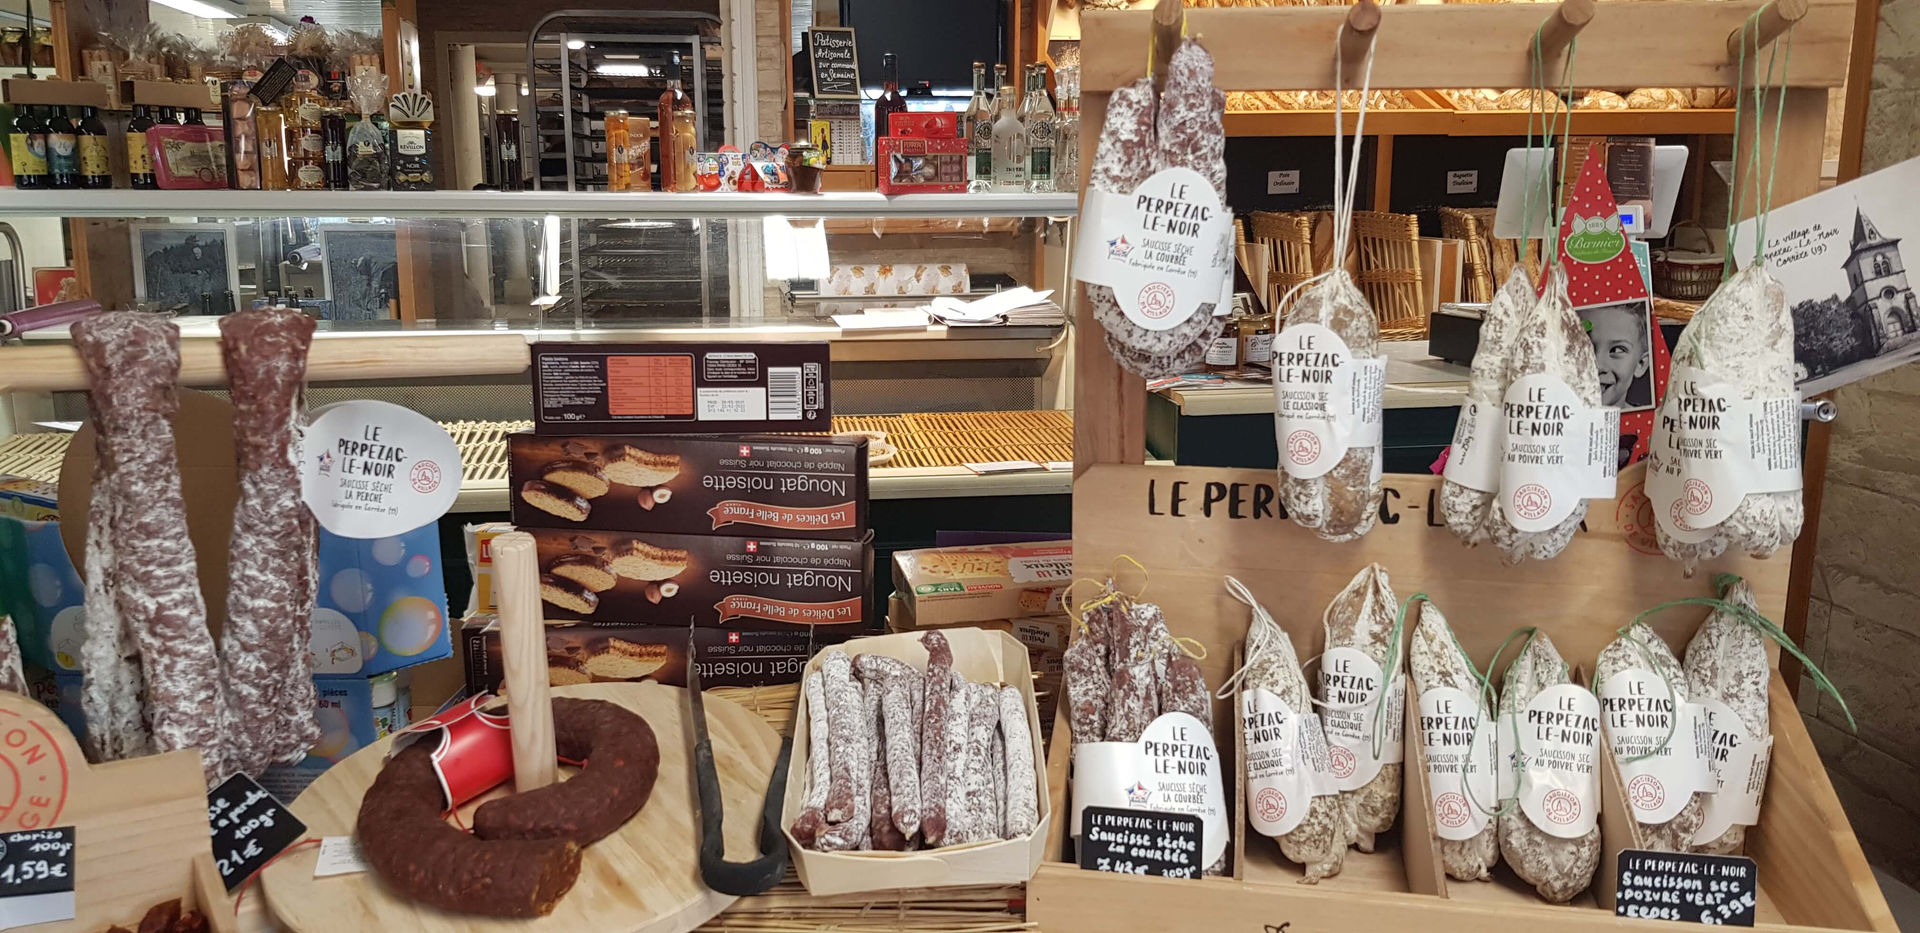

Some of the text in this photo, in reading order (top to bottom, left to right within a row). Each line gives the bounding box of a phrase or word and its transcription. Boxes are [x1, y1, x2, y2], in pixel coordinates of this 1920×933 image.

[1170, 182, 1189, 200] LE
[1136, 195, 1213, 221] PERPEZAC-
[1143, 214, 1200, 238] LE-NOIR
[1783, 228, 1810, 243] village
[1812, 223, 1822, 232] de
[1141, 238, 1171, 251] SAUCISSE
[1569, 235, 1620, 250] Barnier
[1144, 250, 1188, 266] LA COURBÉE
[1300, 335, 1316, 350] LE
[1272, 352, 1345, 367] PERPEZAC-
[1278, 368, 1333, 384] LE-NOIR
[1528, 387, 1547, 403] LE
[1684, 380, 1697, 396] LE
[1282, 391, 1329, 401] SAUCISSON SEC
[1283, 401, 1327, 412] LE CLASSIQUE
[1503, 402, 1575, 420] PERPEZAC-
[364, 425, 383, 441] LE
[1508, 420, 1564, 436] LE-NOIR
[338, 438, 408, 462] PERPEZAC-
[1511, 442, 1560, 454] SAUCISSON SEC
[1705, 438, 1718, 448] SEC
[1507, 453, 1564, 465] AU POIVRE VERT
[1704, 449, 1723, 459] VERT
[342, 457, 396, 479] LE-NOIR
[719, 458, 845, 472] Nappé de chocolat noir Suisse
[339, 478, 369, 490] SAUCISSE
[703, 474, 846, 497] Nougat noisette
[345, 490, 383, 504] LA PERCHE
[1148, 479, 1189, 517] LE
[723, 506, 846, 524] Les Délices de Belle France
[726, 554, 754, 564] Suisse
[755, 555, 771, 563] noir
[773, 555, 808, 565] chocolat
[810, 557, 821, 566] de
[709, 569, 853, 592] Nougat noisette
[730, 601, 852, 619] Les Délices de Belle France
[707, 645, 735, 654] Suisse
[736, 644, 754, 652] noir
[759, 644, 792, 652] chocolat
[770, 659, 808, 677] ugat
[1335, 659, 1350, 673] LE
[1628, 681, 1645, 696] LE
[1436, 699, 1453, 715] LE
[1559, 696, 1577, 711] LE
[1353, 712, 1364, 722] SEC
[1611, 713, 1669, 729] LE-NOIR
[1331, 720, 1362, 732] CLASSIQUE
[1172, 726, 1188, 742] LE
[1423, 732, 1474, 747] LE-NOIR
[1537, 726, 1593, 747] LE-NOIR
[1616, 735, 1653, 745] SAUCISSON
[1145, 741, 1213, 760] PERPEZAC-
[1271, 748, 1282, 758] SEC
[1425, 753, 1459, 763] SAUCISSON
[1539, 748, 1590, 763] SAUCISSON SEC
[1155, 758, 1208, 777] LE-NOIR
[1254, 759, 1283, 771] CLASSIQUE
[1433, 764, 1460, 774] POIVRE
[1534, 758, 1593, 774] AU POIVRE VERT
[1157, 782, 1186, 792] SAUCISSE
[1163, 793, 1204, 804] LA COURBÉE
[1092, 814, 1103, 825] LE
[1089, 827, 1196, 851] Saucisse sèche
[29, 841, 73, 857] 100gr
[1629, 858, 1641, 870] LE
[1622, 871, 1741, 893] Saucisson sec
